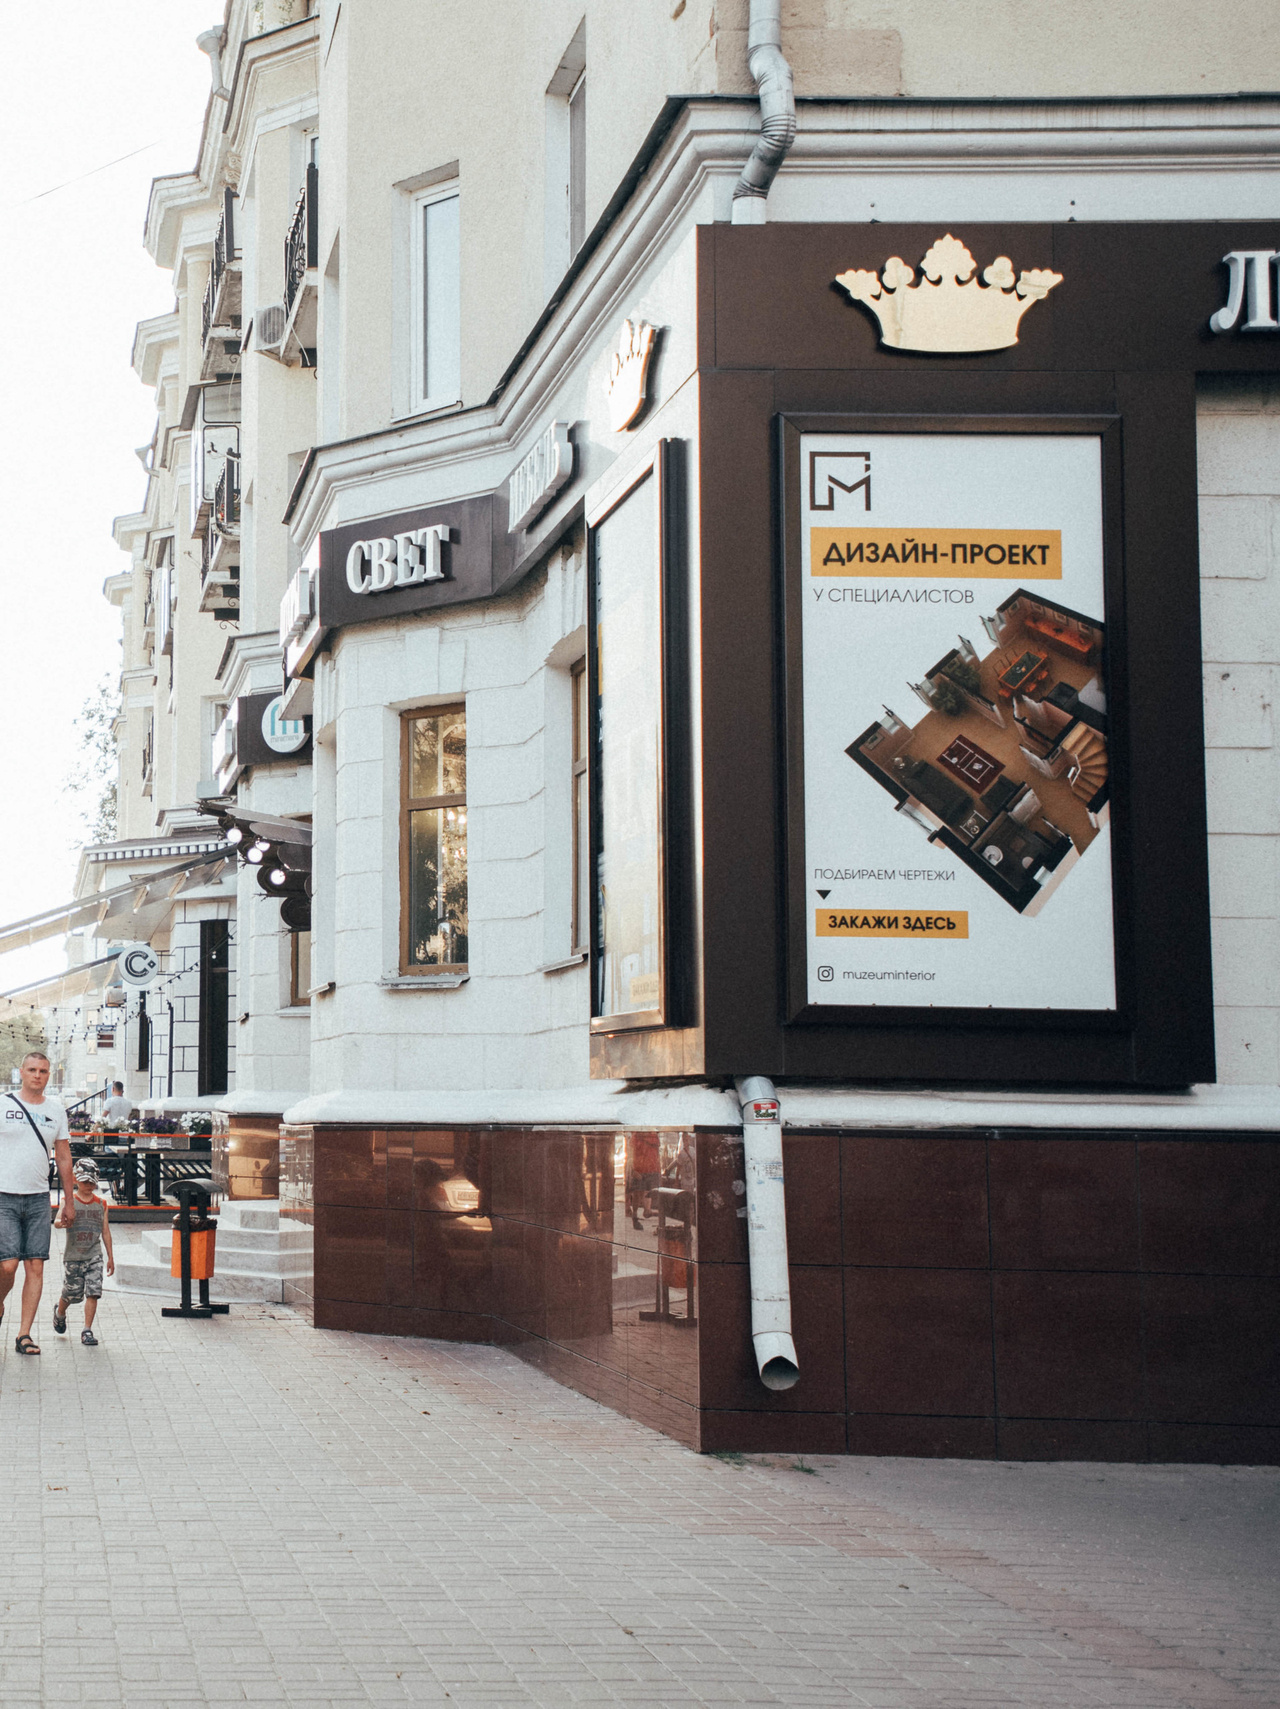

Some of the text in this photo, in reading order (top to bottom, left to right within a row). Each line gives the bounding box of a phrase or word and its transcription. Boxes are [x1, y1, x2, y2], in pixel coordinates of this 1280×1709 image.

[346, 524, 450, 595] СВЕТ
[822, 538, 1050, 567] ДИЗАЙН-ПРОЕКТ
[813, 588, 975, 604] У СПЕЦИАЛИСТОВ
[814, 868, 956, 881] ПОДБИРАЕМ ЧЕРТЕЖИ
[828, 915, 957, 932] ЗАКАЖИ ЗДЕСЬ
[842, 969, 936, 981] muzeuminterior
